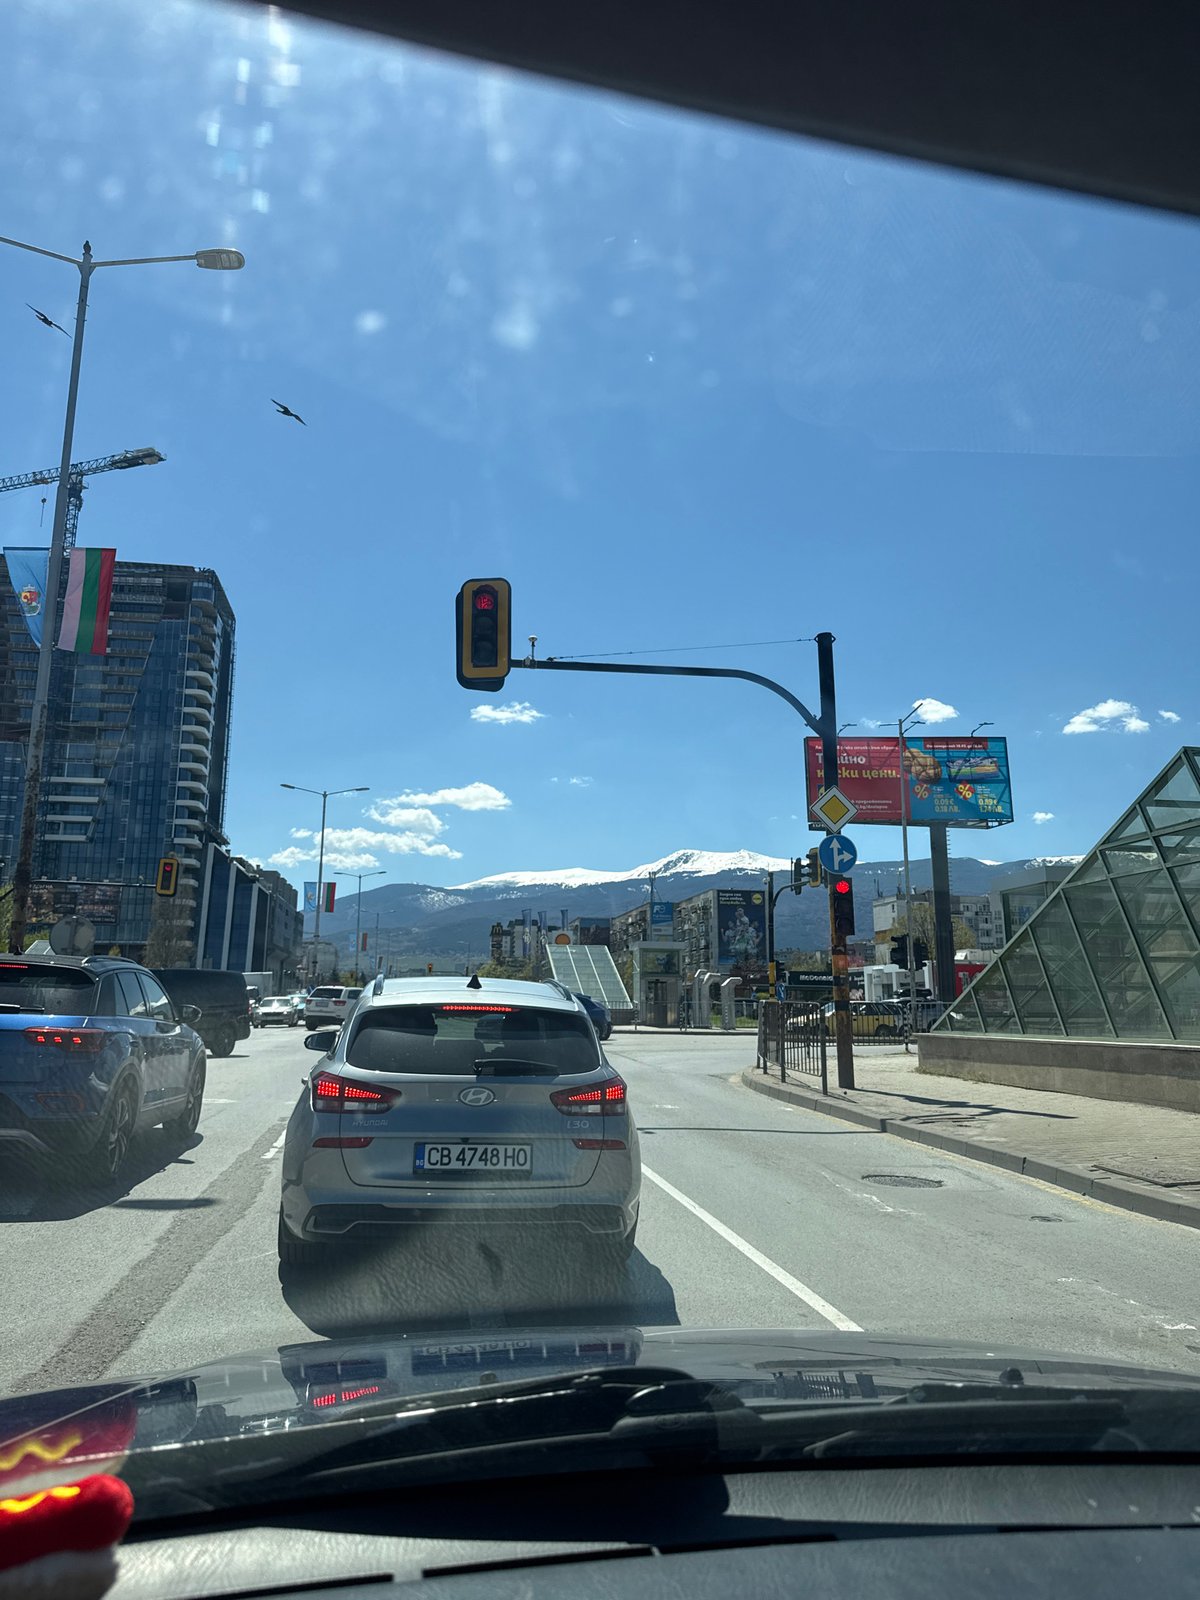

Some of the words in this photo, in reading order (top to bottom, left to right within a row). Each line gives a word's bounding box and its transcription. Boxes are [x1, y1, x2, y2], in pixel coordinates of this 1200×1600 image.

[816, 752, 866, 764] Тйно
[816, 767, 859, 778] нки
[862, 769, 901, 780] цени.
[427, 1147, 451, 1166] CB
[456, 1147, 500, 1166] 4748
